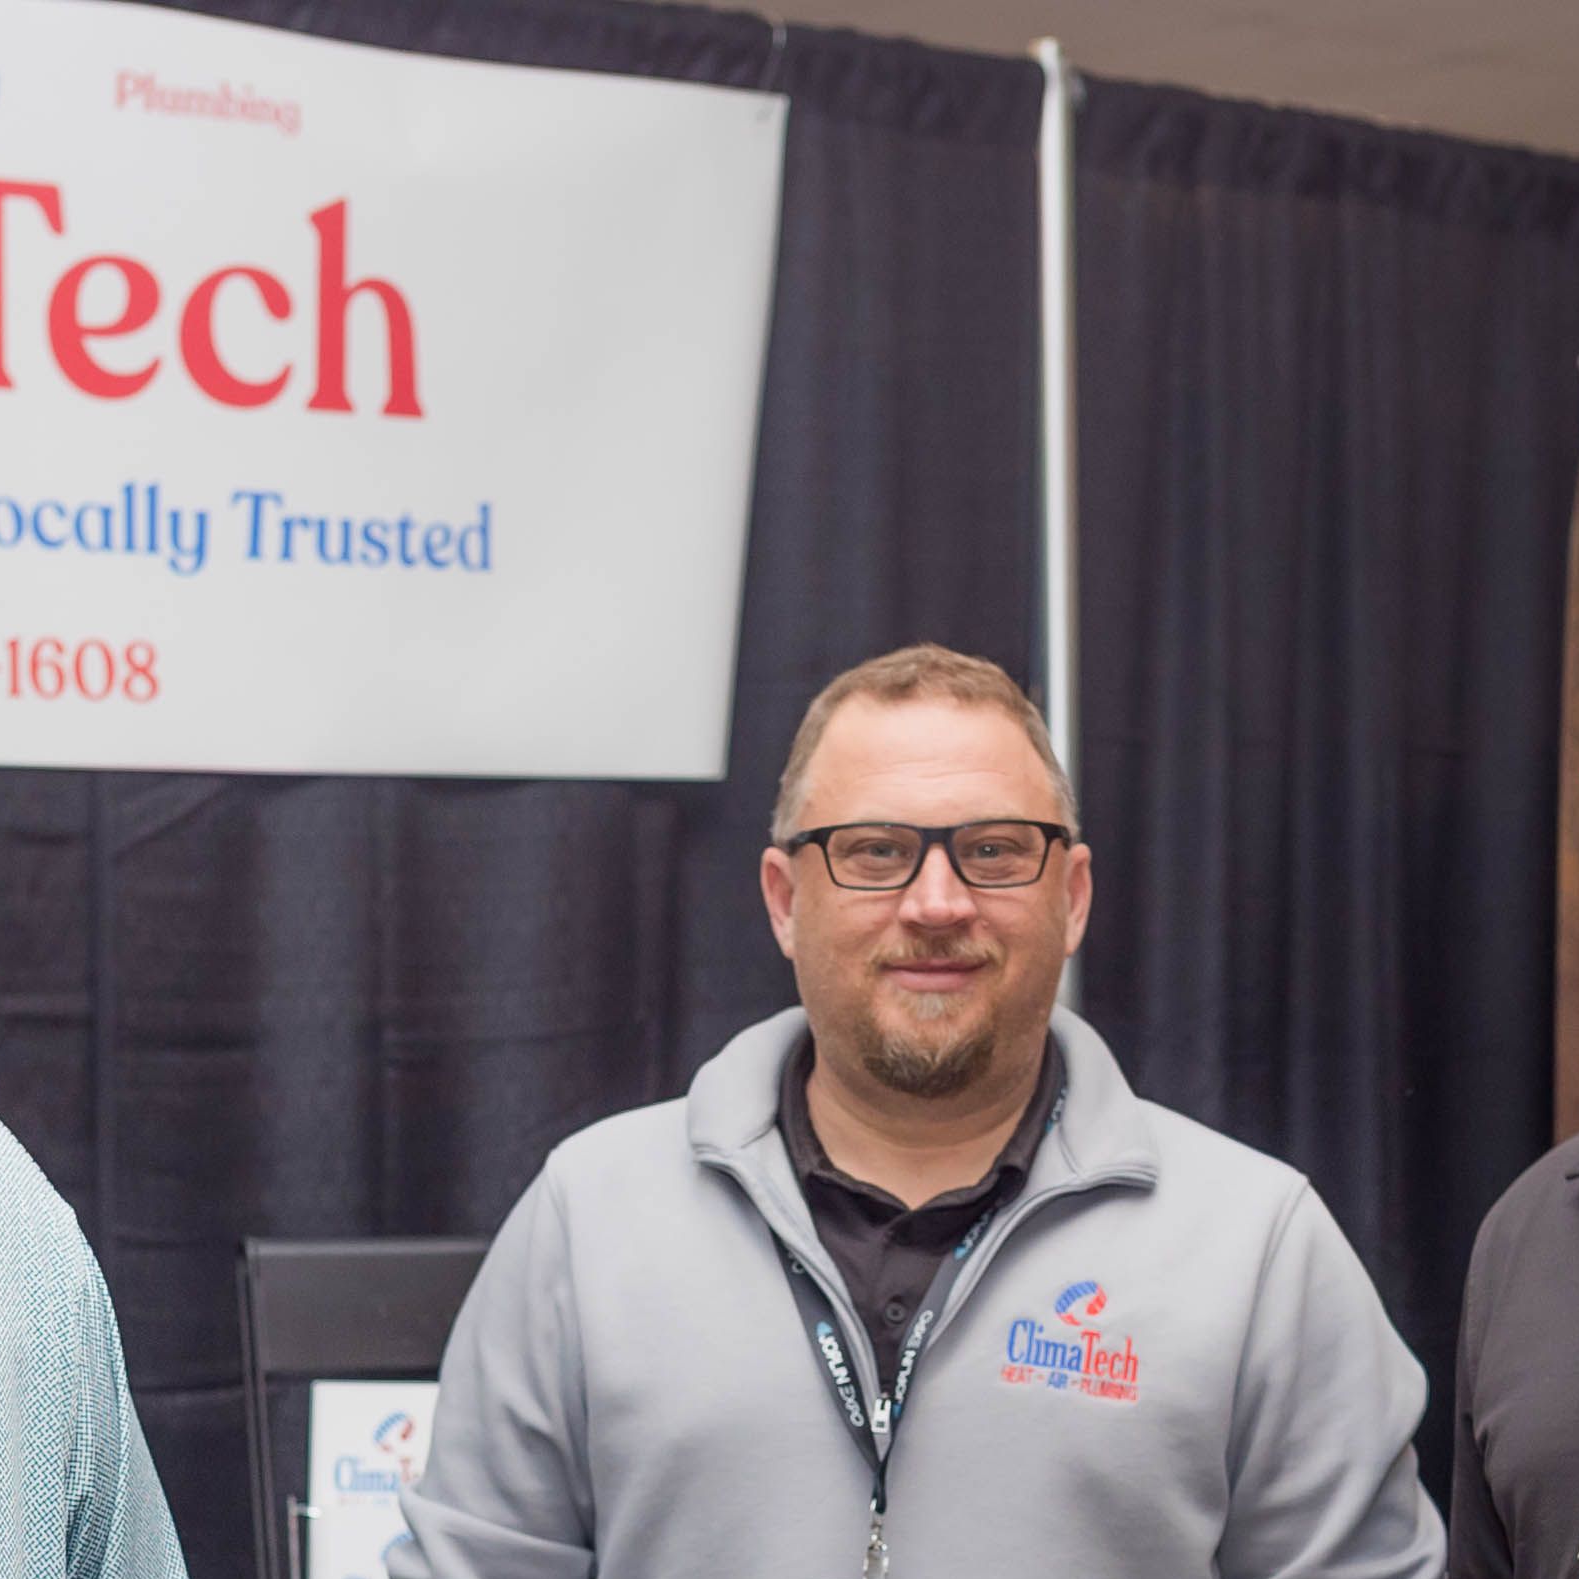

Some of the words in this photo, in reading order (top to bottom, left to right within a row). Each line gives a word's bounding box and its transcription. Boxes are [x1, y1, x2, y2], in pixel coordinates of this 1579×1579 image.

[115, 70, 301, 137] Plumbing
[232, 490, 493, 573] Trusted
[819, 1335, 852, 1386] JOPLIN
[838, 1382, 865, 1428] EXPO
[895, 1350, 917, 1404] JOPLIN
[1007, 1317, 1139, 1384] ClimaTech
